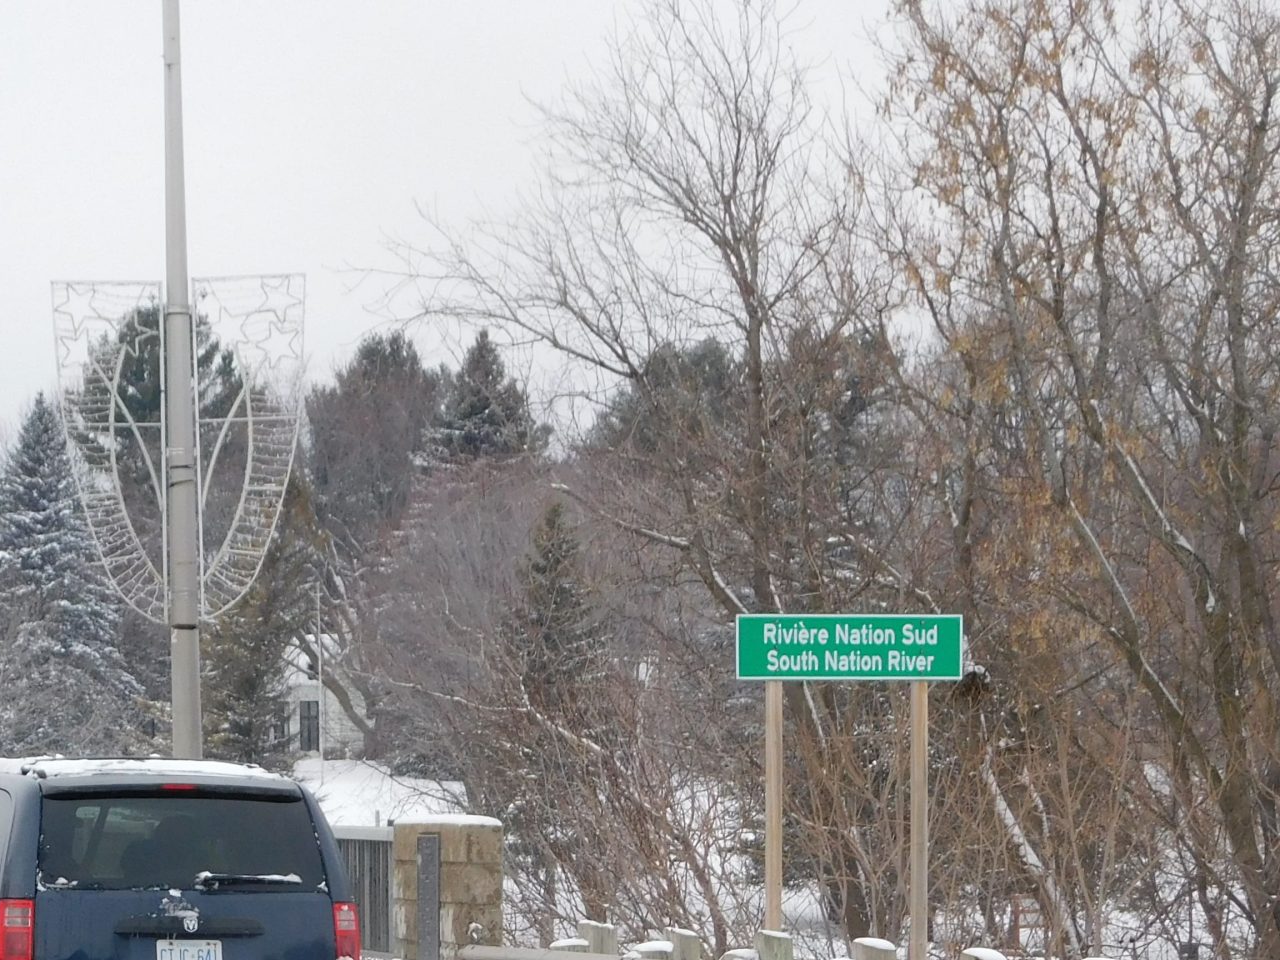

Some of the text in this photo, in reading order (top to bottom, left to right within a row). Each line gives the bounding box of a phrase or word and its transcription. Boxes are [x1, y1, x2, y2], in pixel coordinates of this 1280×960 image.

[763, 621, 938, 645] Rivière Nation Sud
[766, 650, 935, 671] South Nation River
